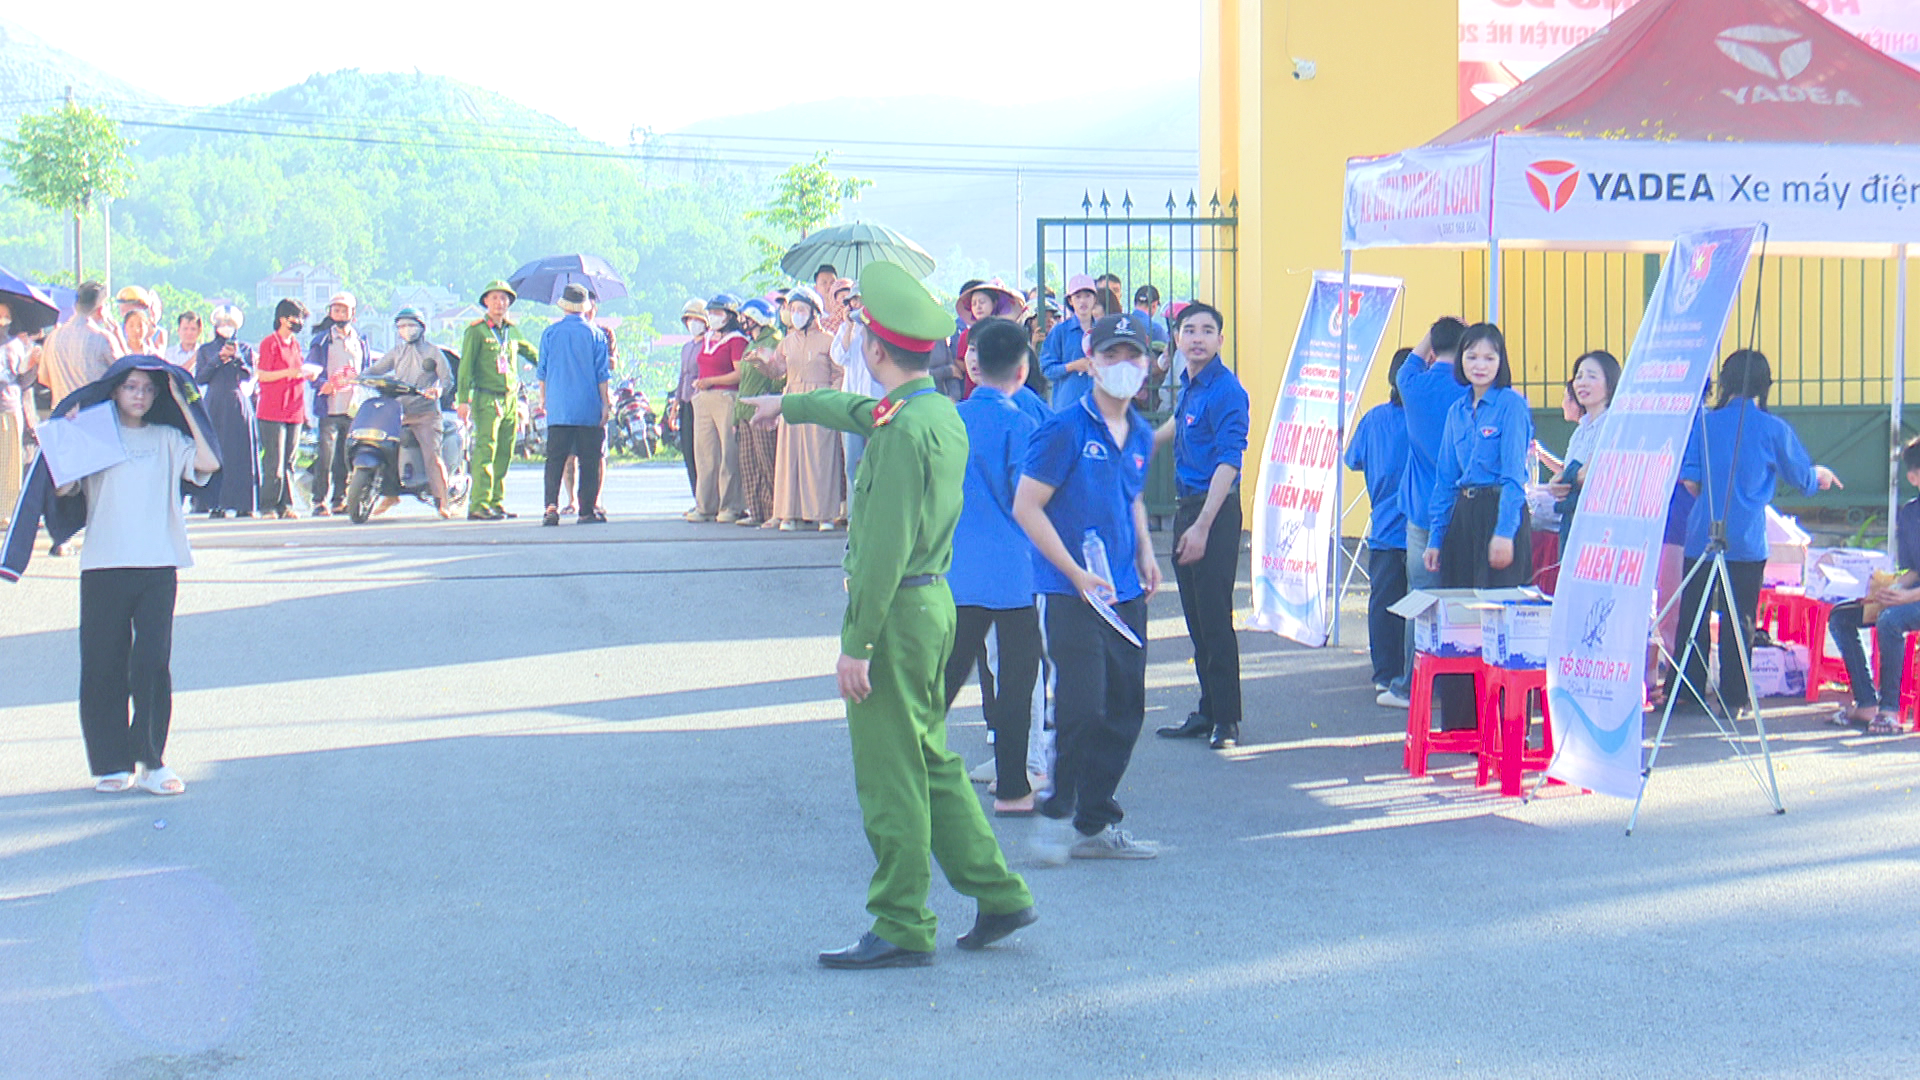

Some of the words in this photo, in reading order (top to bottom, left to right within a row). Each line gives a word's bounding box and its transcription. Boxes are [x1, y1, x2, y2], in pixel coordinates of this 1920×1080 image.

[1720, 84, 1863, 108] YADEA
[1444, 165, 1482, 215] LOAN
[1587, 172, 1714, 201] YADEA
[1729, 174, 1770, 202] Xe
[1783, 172, 1850, 210] máy
[1300, 365, 1327, 379] CHƯƠNG
[1328, 366, 1348, 380] TRÌ
[1324, 389, 1335, 401] THI
[1300, 483, 1324, 513] PHÍ
[1305, 560, 1317, 574] THI
[1615, 540, 1648, 586] PHÍ
[1559, 649, 1574, 676] TIẾP
[1574, 655, 1593, 678] SỨC
[1592, 656, 1615, 681] MÙA
[1616, 661, 1631, 682] THI
